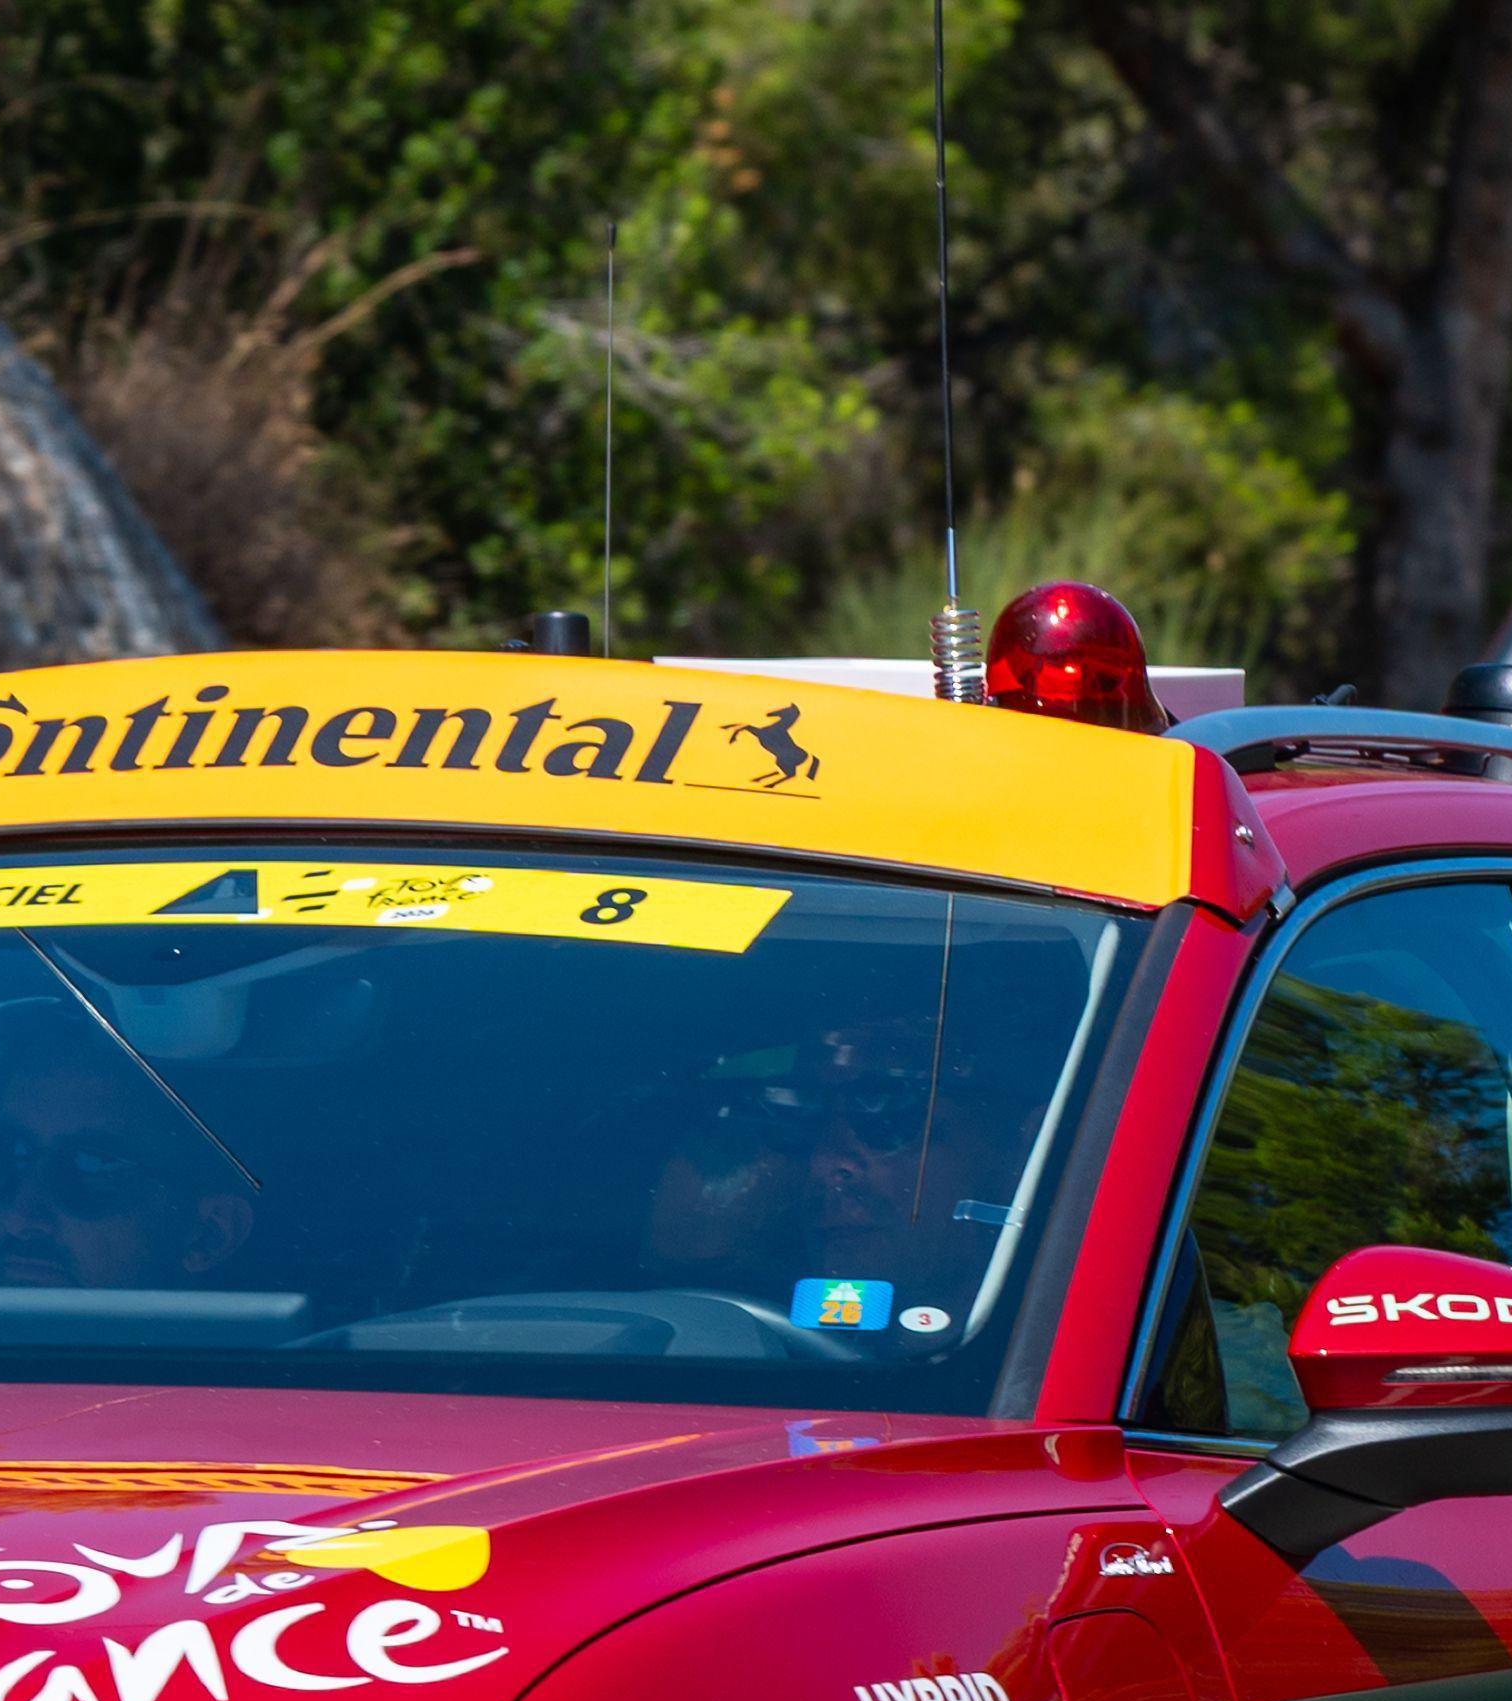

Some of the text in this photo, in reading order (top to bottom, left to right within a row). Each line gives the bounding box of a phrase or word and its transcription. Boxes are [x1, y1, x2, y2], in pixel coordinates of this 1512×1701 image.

[580, 887, 648, 925] 8
[918, 1313, 932, 1326] 3
[203, 1571, 316, 1605] de
